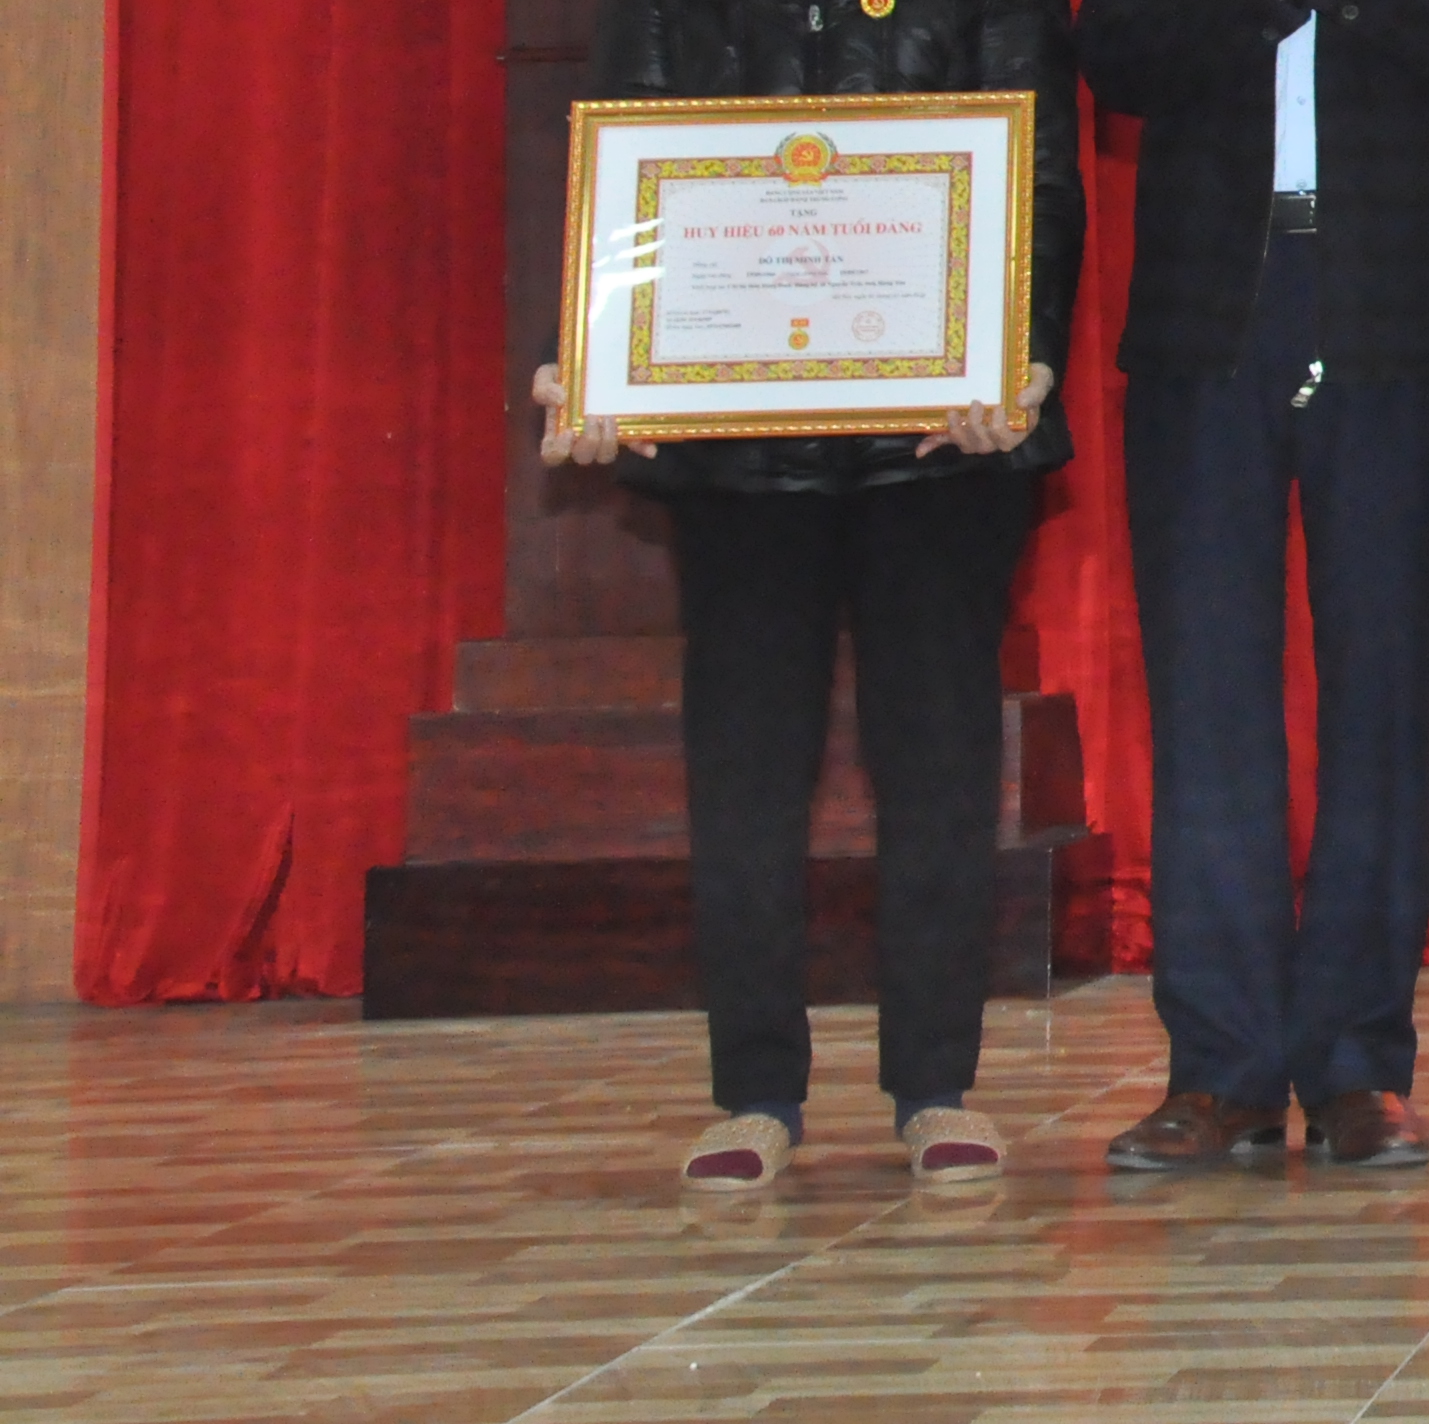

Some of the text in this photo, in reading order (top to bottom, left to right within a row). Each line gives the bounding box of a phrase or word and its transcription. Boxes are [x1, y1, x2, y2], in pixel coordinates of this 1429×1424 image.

[683, 226, 718, 239] HUY
[768, 225, 785, 237] 60
[876, 217, 923, 235] ĐẢNG
